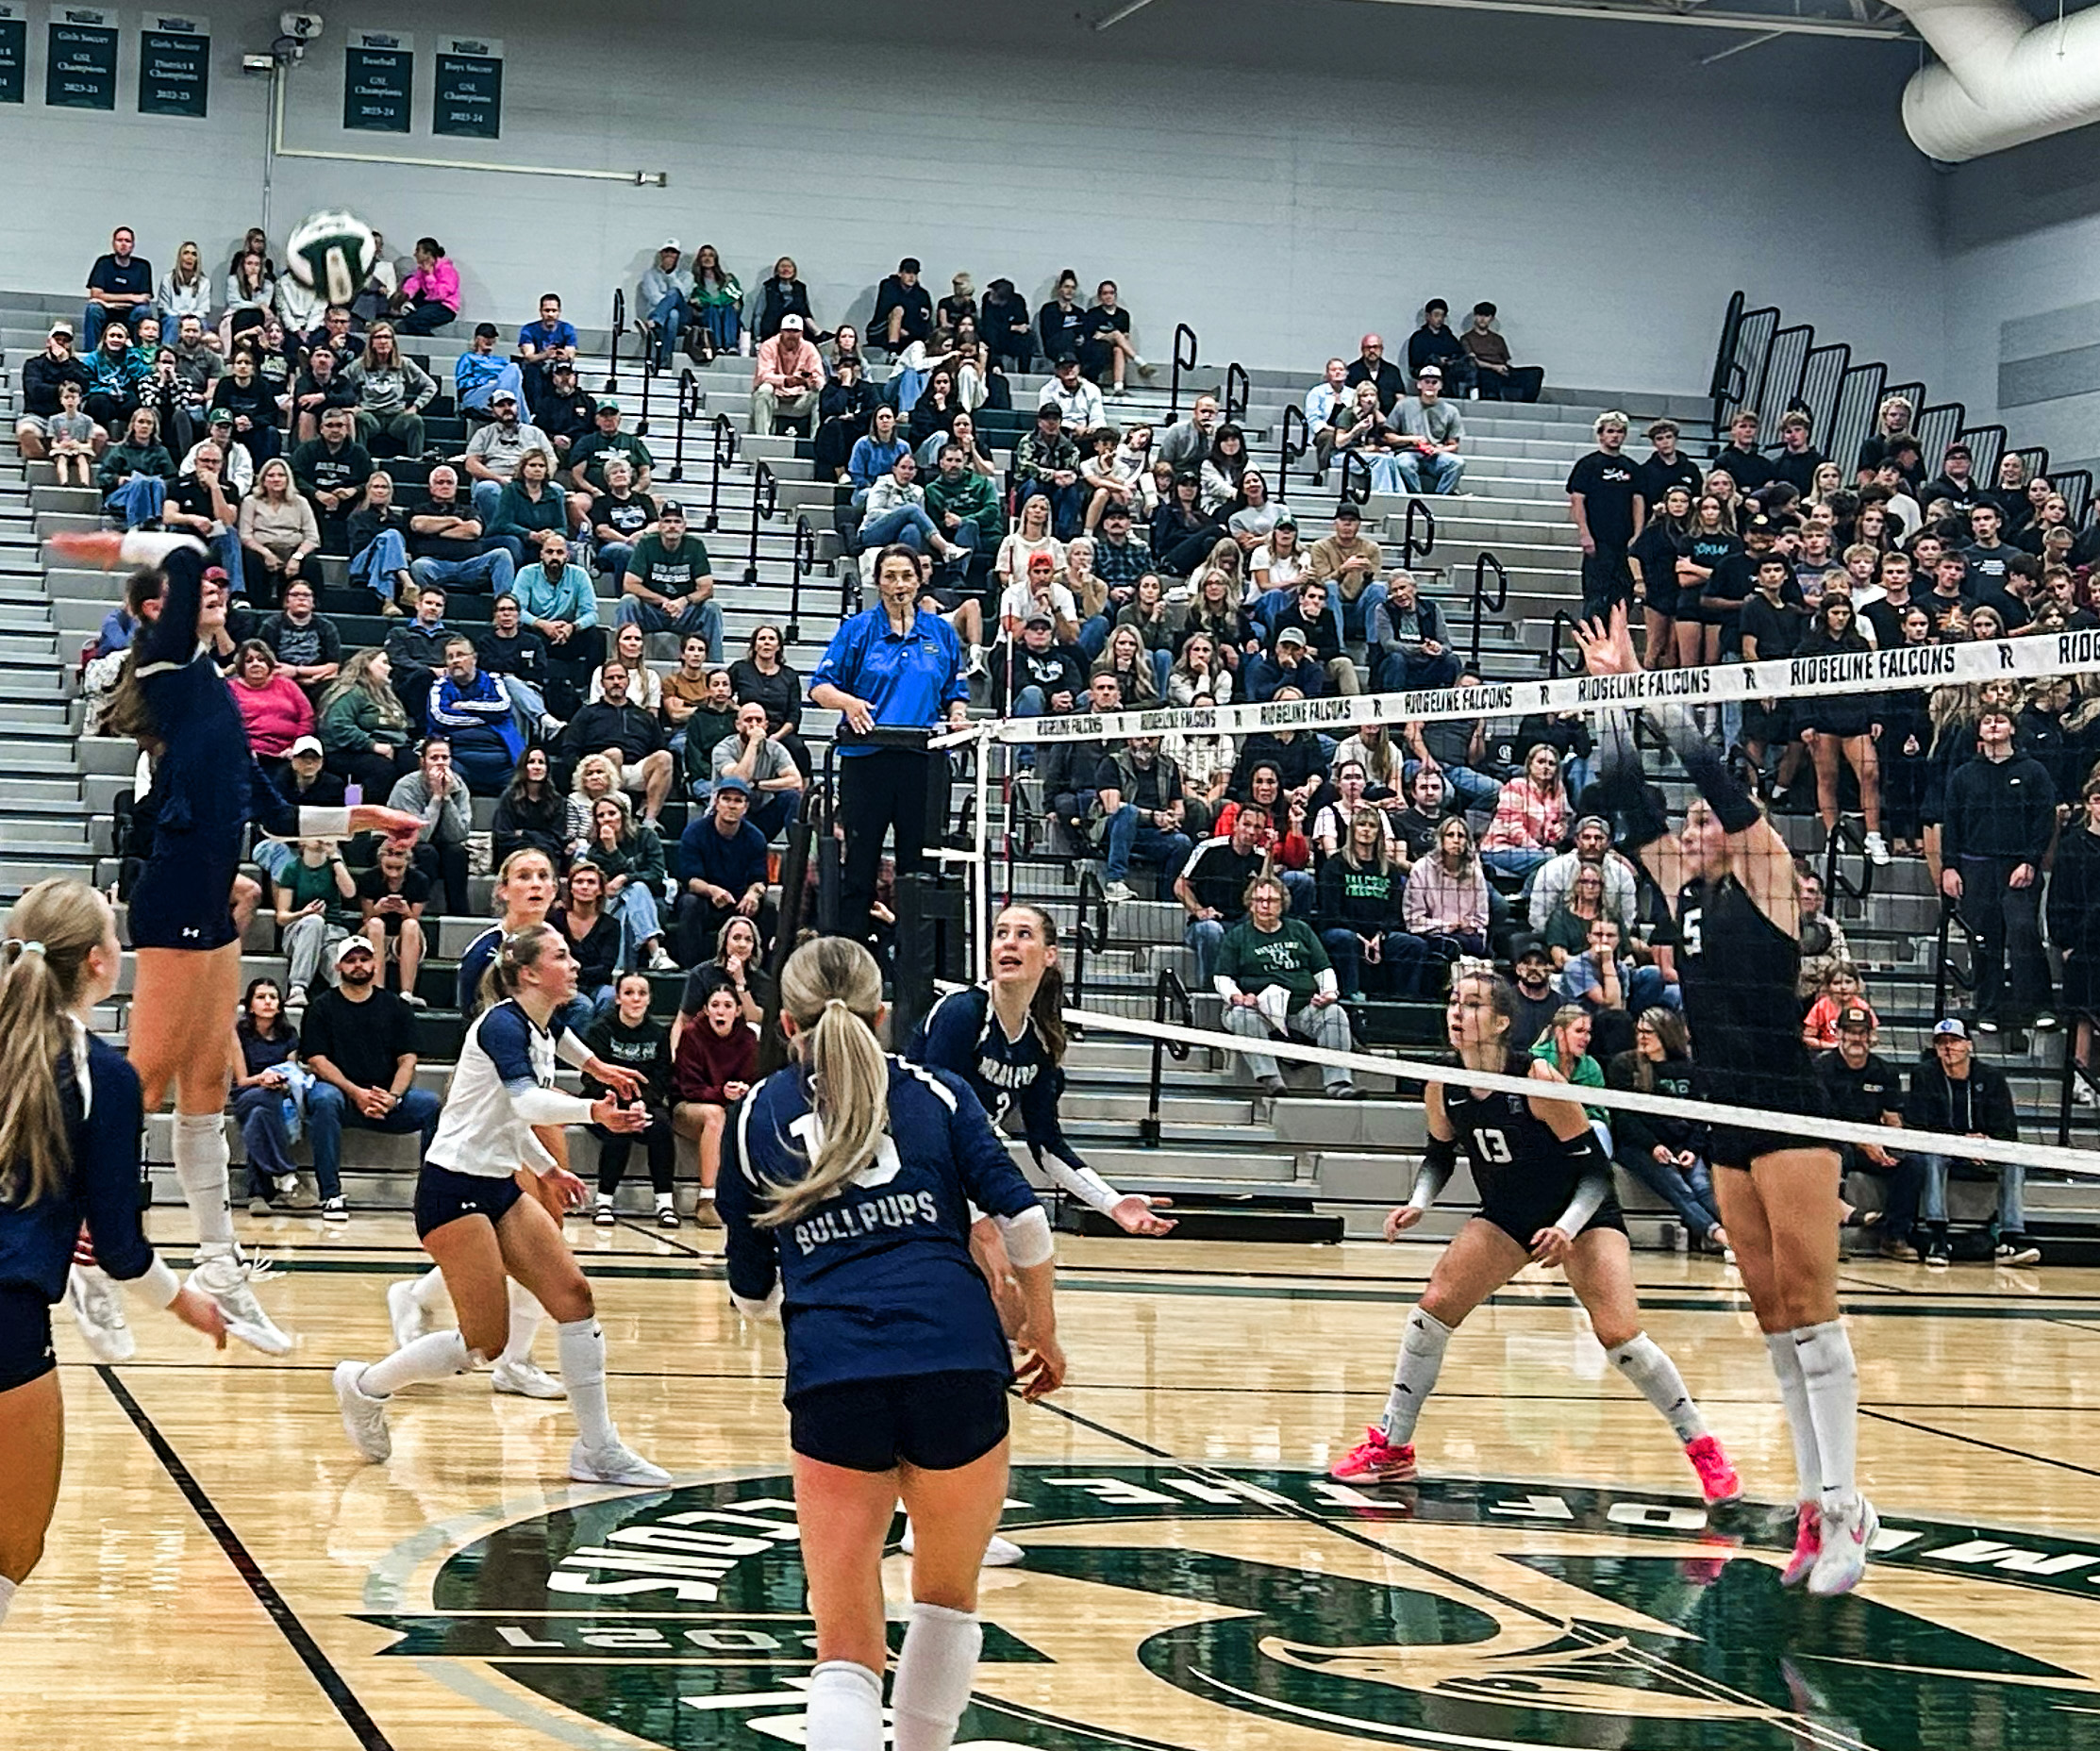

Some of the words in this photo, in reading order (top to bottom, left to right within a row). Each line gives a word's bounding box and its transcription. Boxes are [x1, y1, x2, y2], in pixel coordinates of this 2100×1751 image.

[58, 61, 107, 74] Champions
[155, 58, 187, 70] District
[362, 56, 396, 67] Baseball
[444, 61, 464, 73] Boys
[467, 65, 492, 74] Soccer
[149, 69, 198, 81] Champions
[370, 76, 388, 86] GSL
[355, 86, 403, 98] Champions
[458, 83, 477, 92] GSL
[443, 92, 492, 104] Champions
[1791, 654, 1874, 686] RIDGELINE
[1879, 647, 1956, 677] FALCONS
[1578, 674, 1644, 702] RIDGELINE
[1648, 669, 1710, 696] FALCONS
[1405, 691, 1461, 714] RIDGELINE
[1462, 686, 1513, 710] FALCONS
[1260, 703, 1308, 725] RIDGELINE
[1309, 699, 1351, 721] FALCONS
[1683, 907, 1703, 957] 5
[1473, 1127, 1513, 1164] 13
[794, 1190, 939, 1256] BULLPUPS
[494, 1626, 818, 1650] 021
